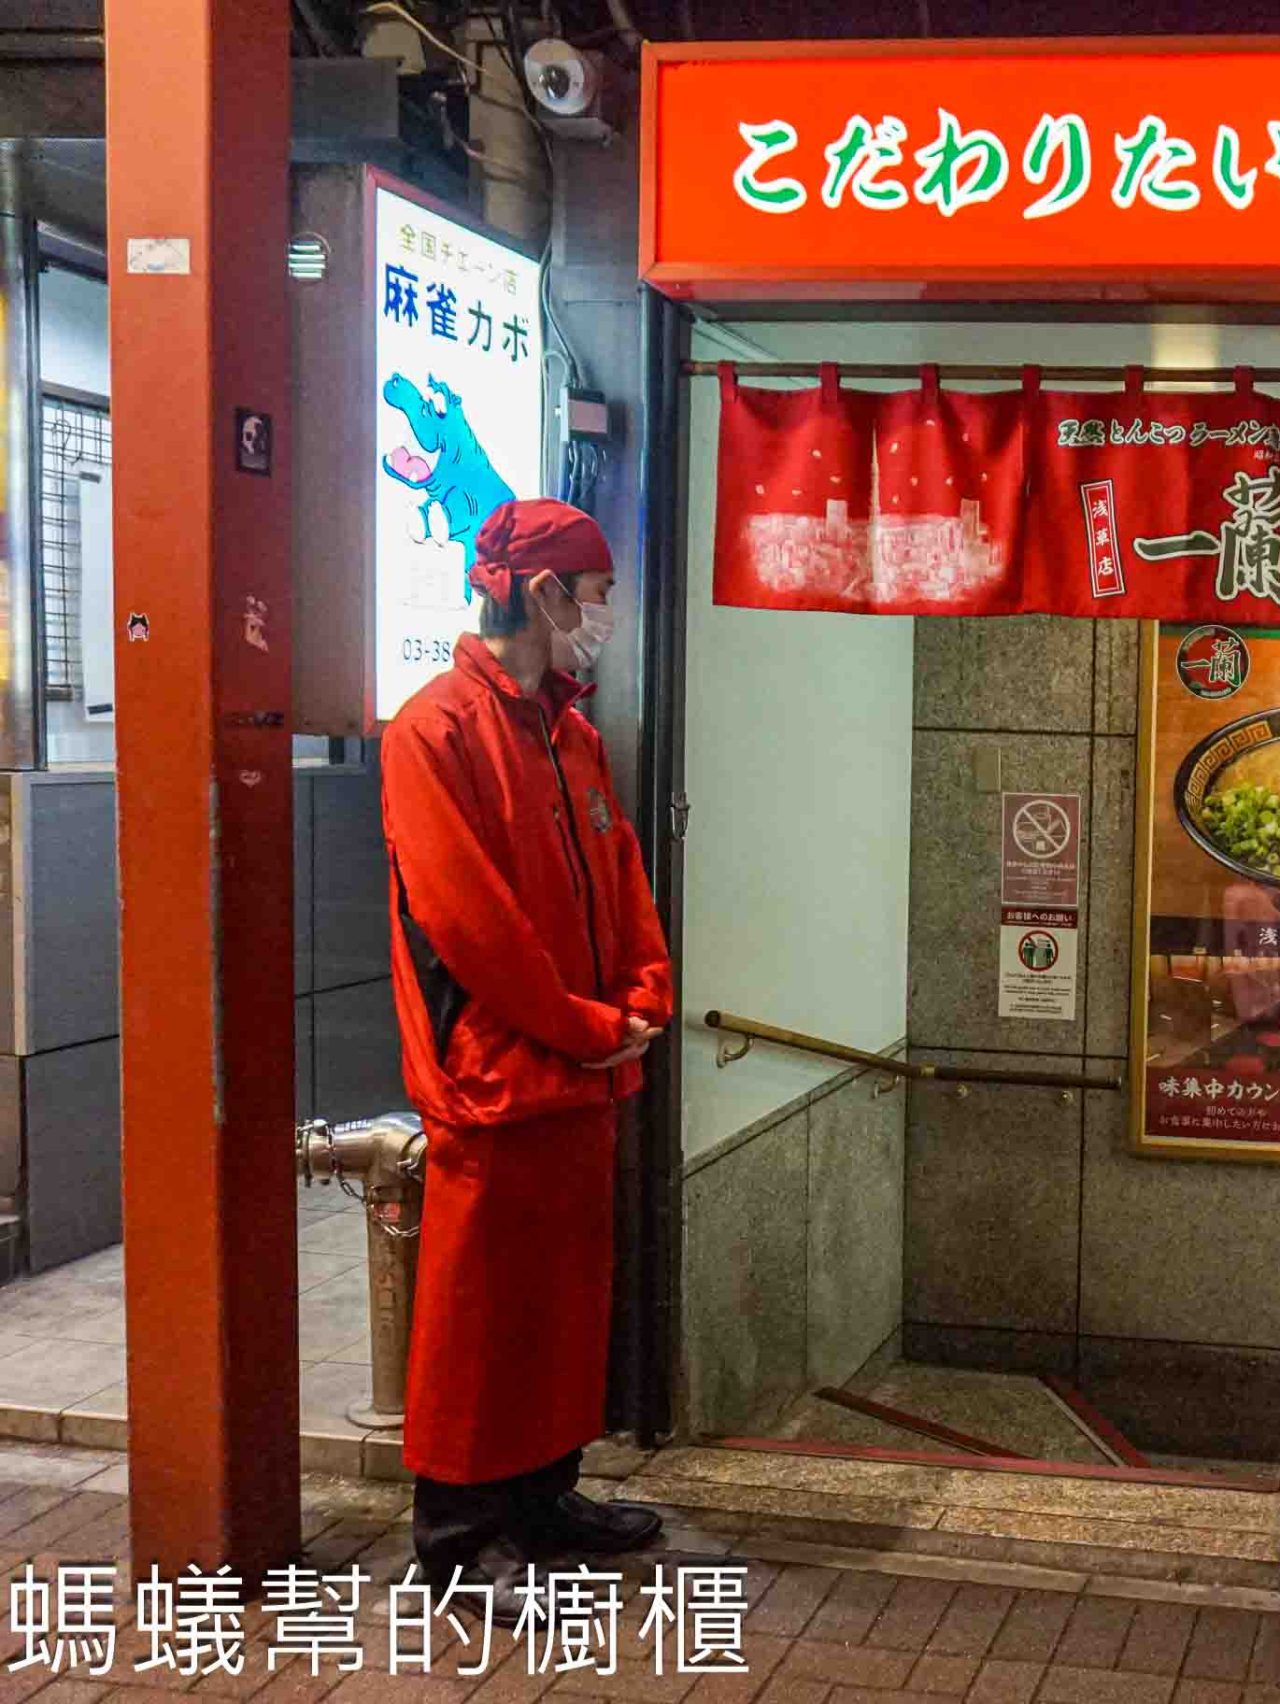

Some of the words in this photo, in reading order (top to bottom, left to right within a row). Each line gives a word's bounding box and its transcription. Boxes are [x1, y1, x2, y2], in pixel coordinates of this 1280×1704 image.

[384, 262, 529, 362] 麻雀カボ
[1092, 500, 1116, 576] 浅草店
[1180, 636, 1242, 688] 一蘭
